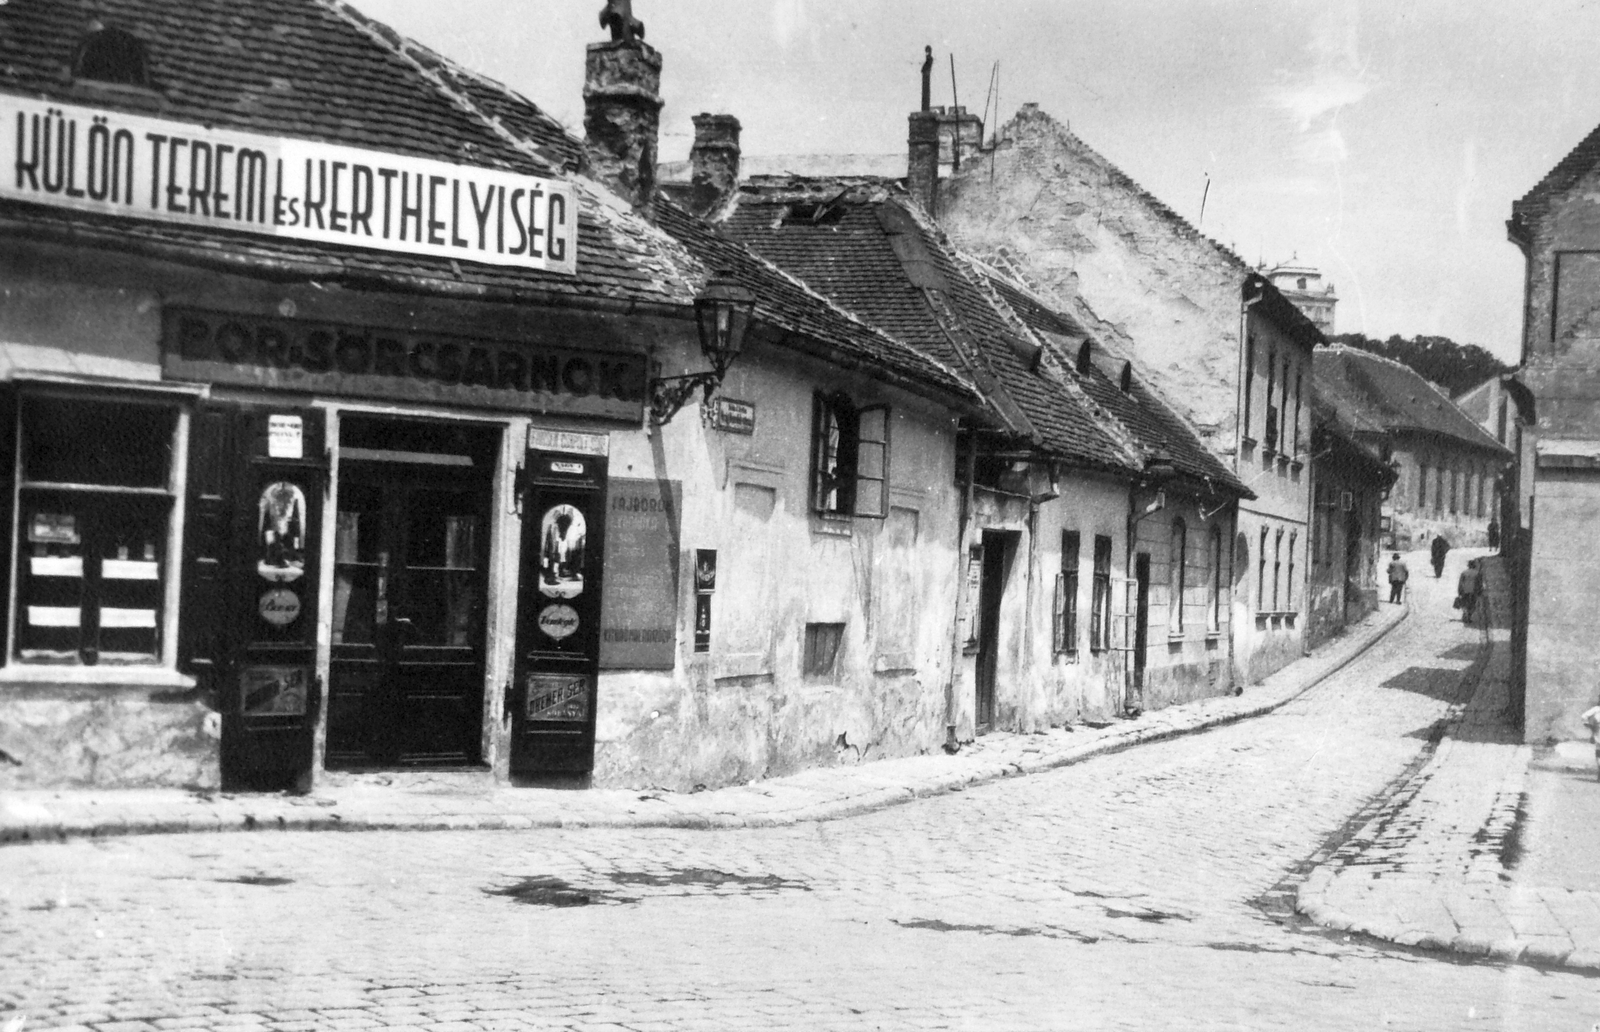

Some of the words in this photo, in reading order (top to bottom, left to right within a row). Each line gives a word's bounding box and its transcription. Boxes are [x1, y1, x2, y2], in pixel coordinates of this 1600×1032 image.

[16, 107, 134, 205] KÜLÖN
[146, 132, 267, 224] TEREM
[304, 158, 565, 262] KERTHELYISÉG
